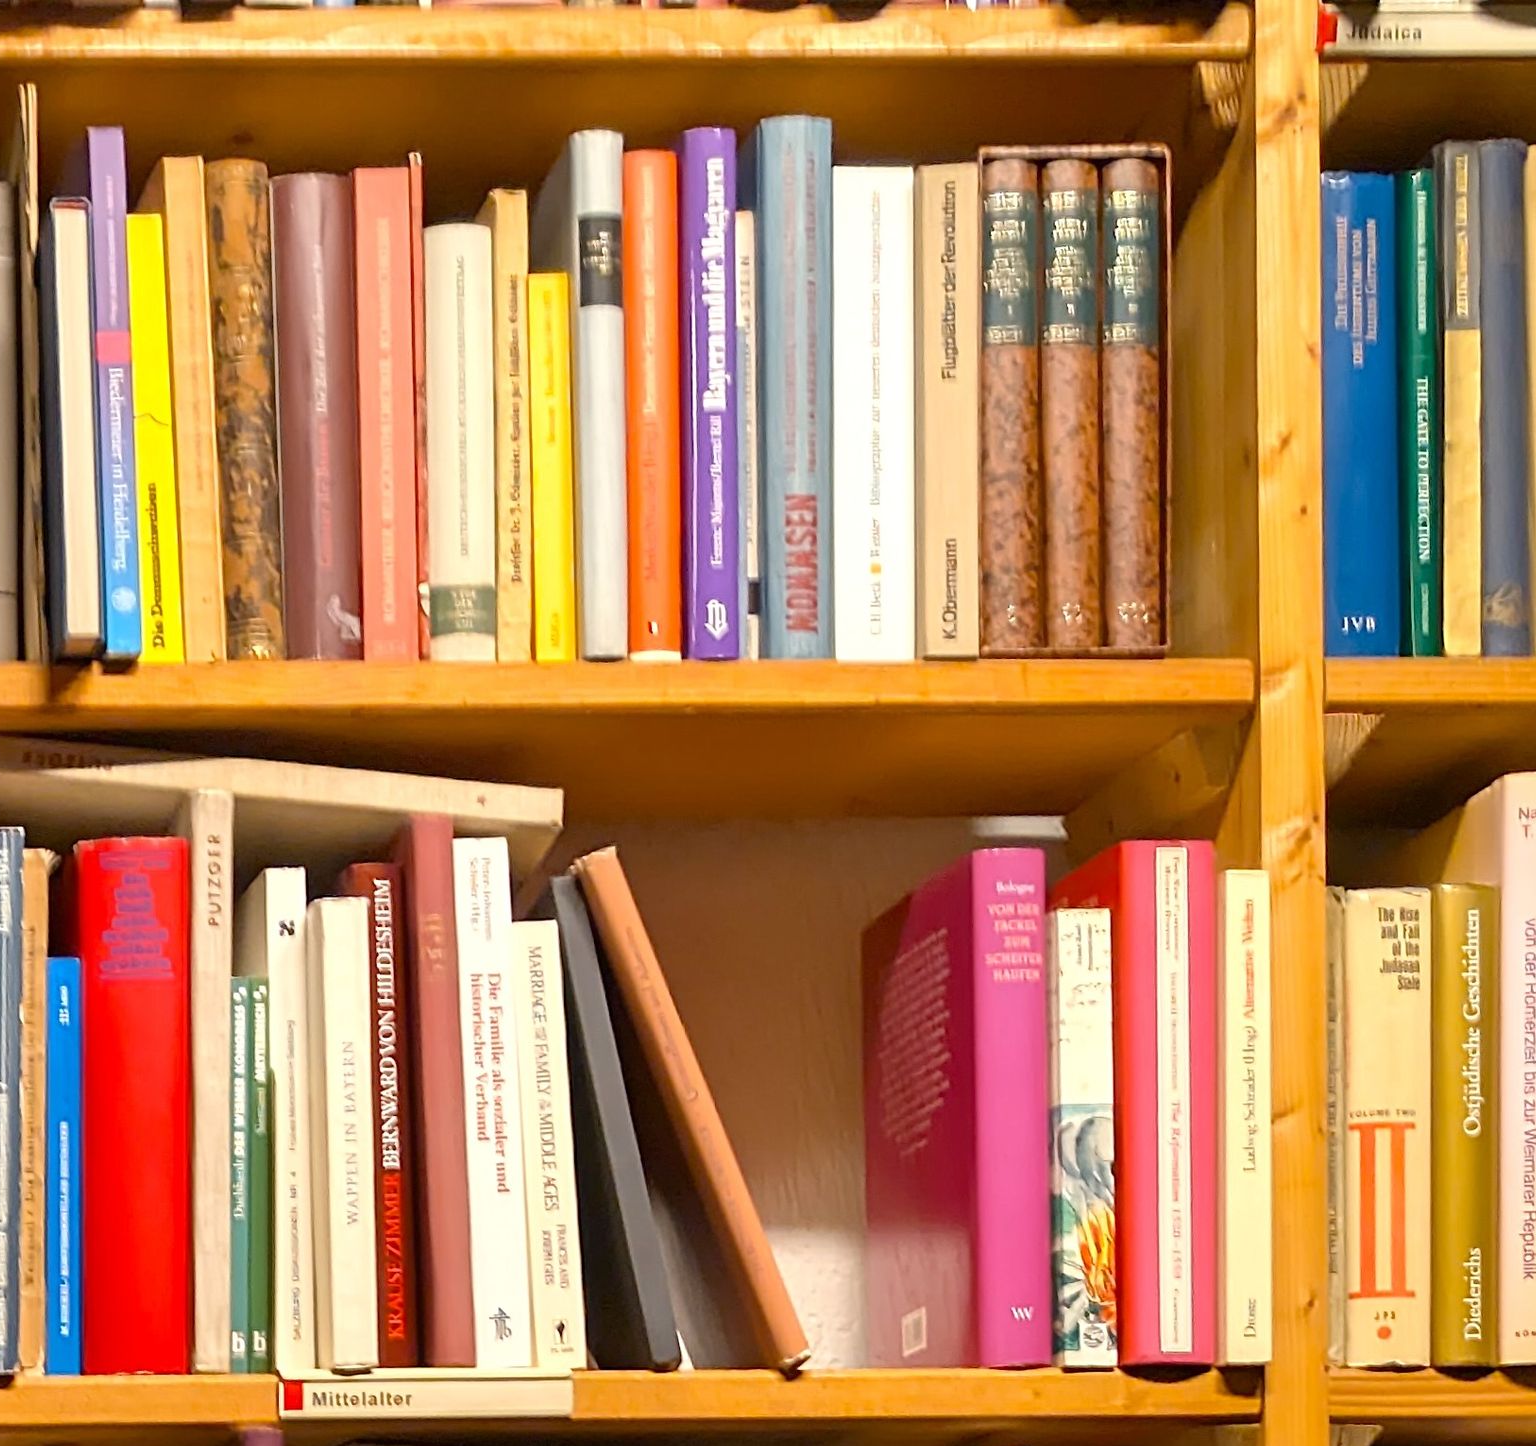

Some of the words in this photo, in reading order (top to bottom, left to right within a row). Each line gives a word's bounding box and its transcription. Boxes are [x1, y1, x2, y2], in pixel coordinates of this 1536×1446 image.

[941, 181, 958, 264] Revolution
[941, 267, 956, 292] der
[941, 296, 959, 380] Flugblätter
[372, 879, 395, 1004] HILDESHEIM
[1461, 909, 1482, 1021] Geschichten
[377, 1010, 399, 1056] VON
[380, 1057, 402, 1169] BERNWARD
[1461, 1028, 1483, 1136] Ostjüdische
[1463, 1248, 1483, 1340] Diederichs
[311, 1391, 413, 1407] Mittelalter
